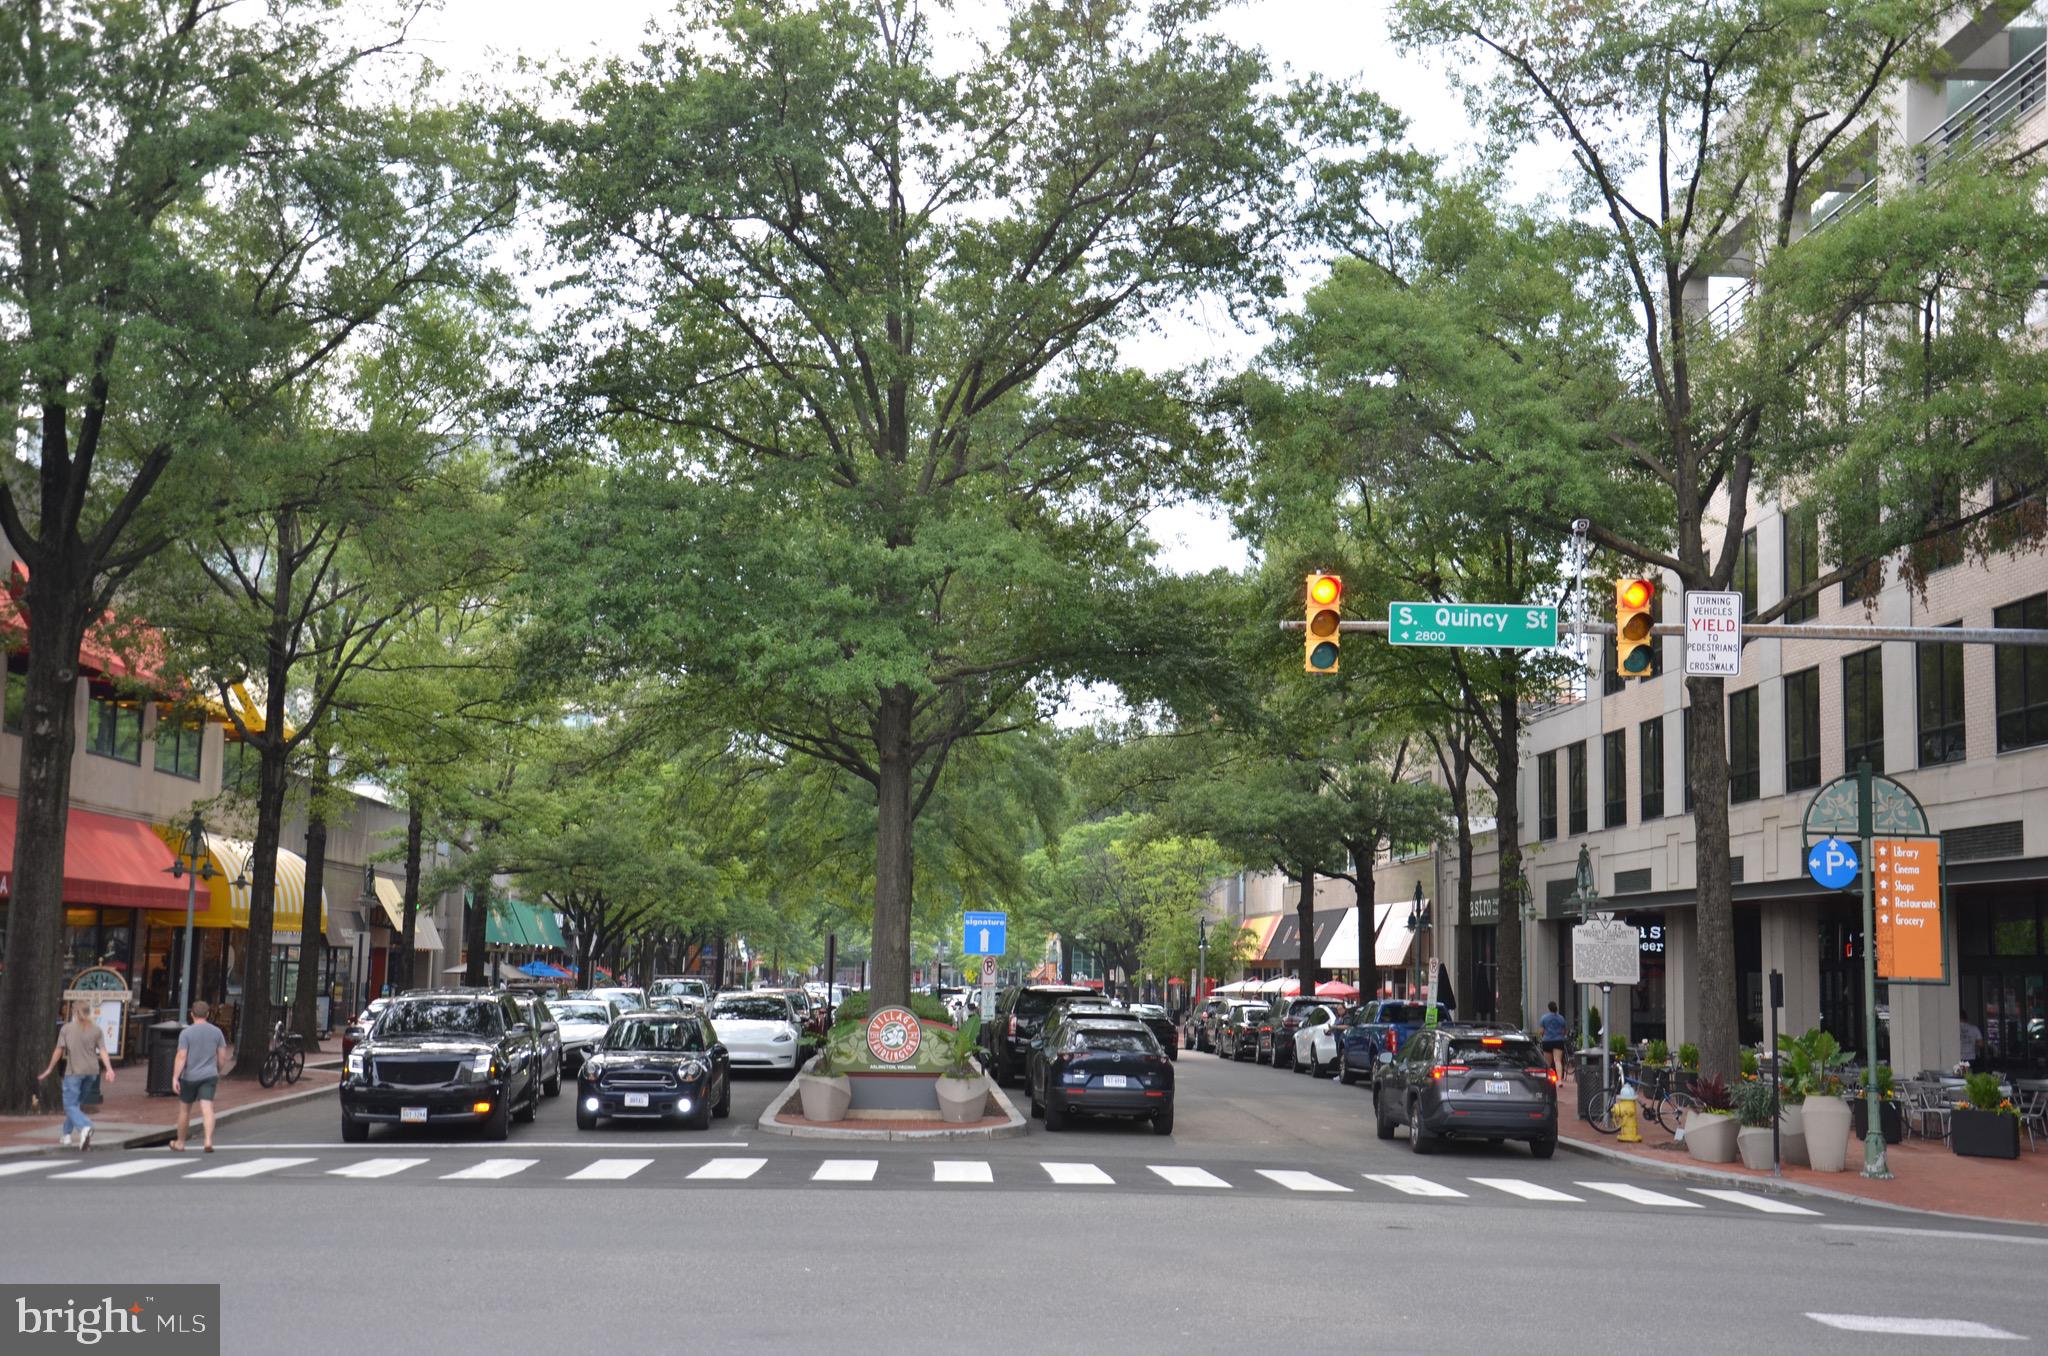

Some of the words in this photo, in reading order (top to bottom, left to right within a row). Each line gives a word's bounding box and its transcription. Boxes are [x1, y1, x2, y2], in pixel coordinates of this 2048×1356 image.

[1696, 596, 1731, 606] TURNING
[1694, 607, 1733, 616] VEHICLES
[1399, 606, 1418, 626] S.
[1435, 607, 1509, 632] Quincy
[1526, 610, 1549, 630] St
[1692, 618, 1735, 632] YIELD
[1415, 631, 1446, 642] 2800
[1707, 633, 1719, 642] TO
[1687, 643, 1738, 653] PEDESTRIANS
[1708, 653, 1716, 661] IN
[1689, 662, 1735, 671] CROSSWALK
[1893, 845, 1920, 860] Library
[1825, 850, 1845, 876] P
[1894, 862, 1920, 875] Cinema
[1894, 879, 1915, 893] Shops
[1894, 896, 1937, 909] Restaurants
[965, 918, 1005, 926] signature
[1895, 913, 1925, 929] Grocery
[1639, 941, 1664, 952] eer
[871, 1010, 916, 1030] VILLAGE
